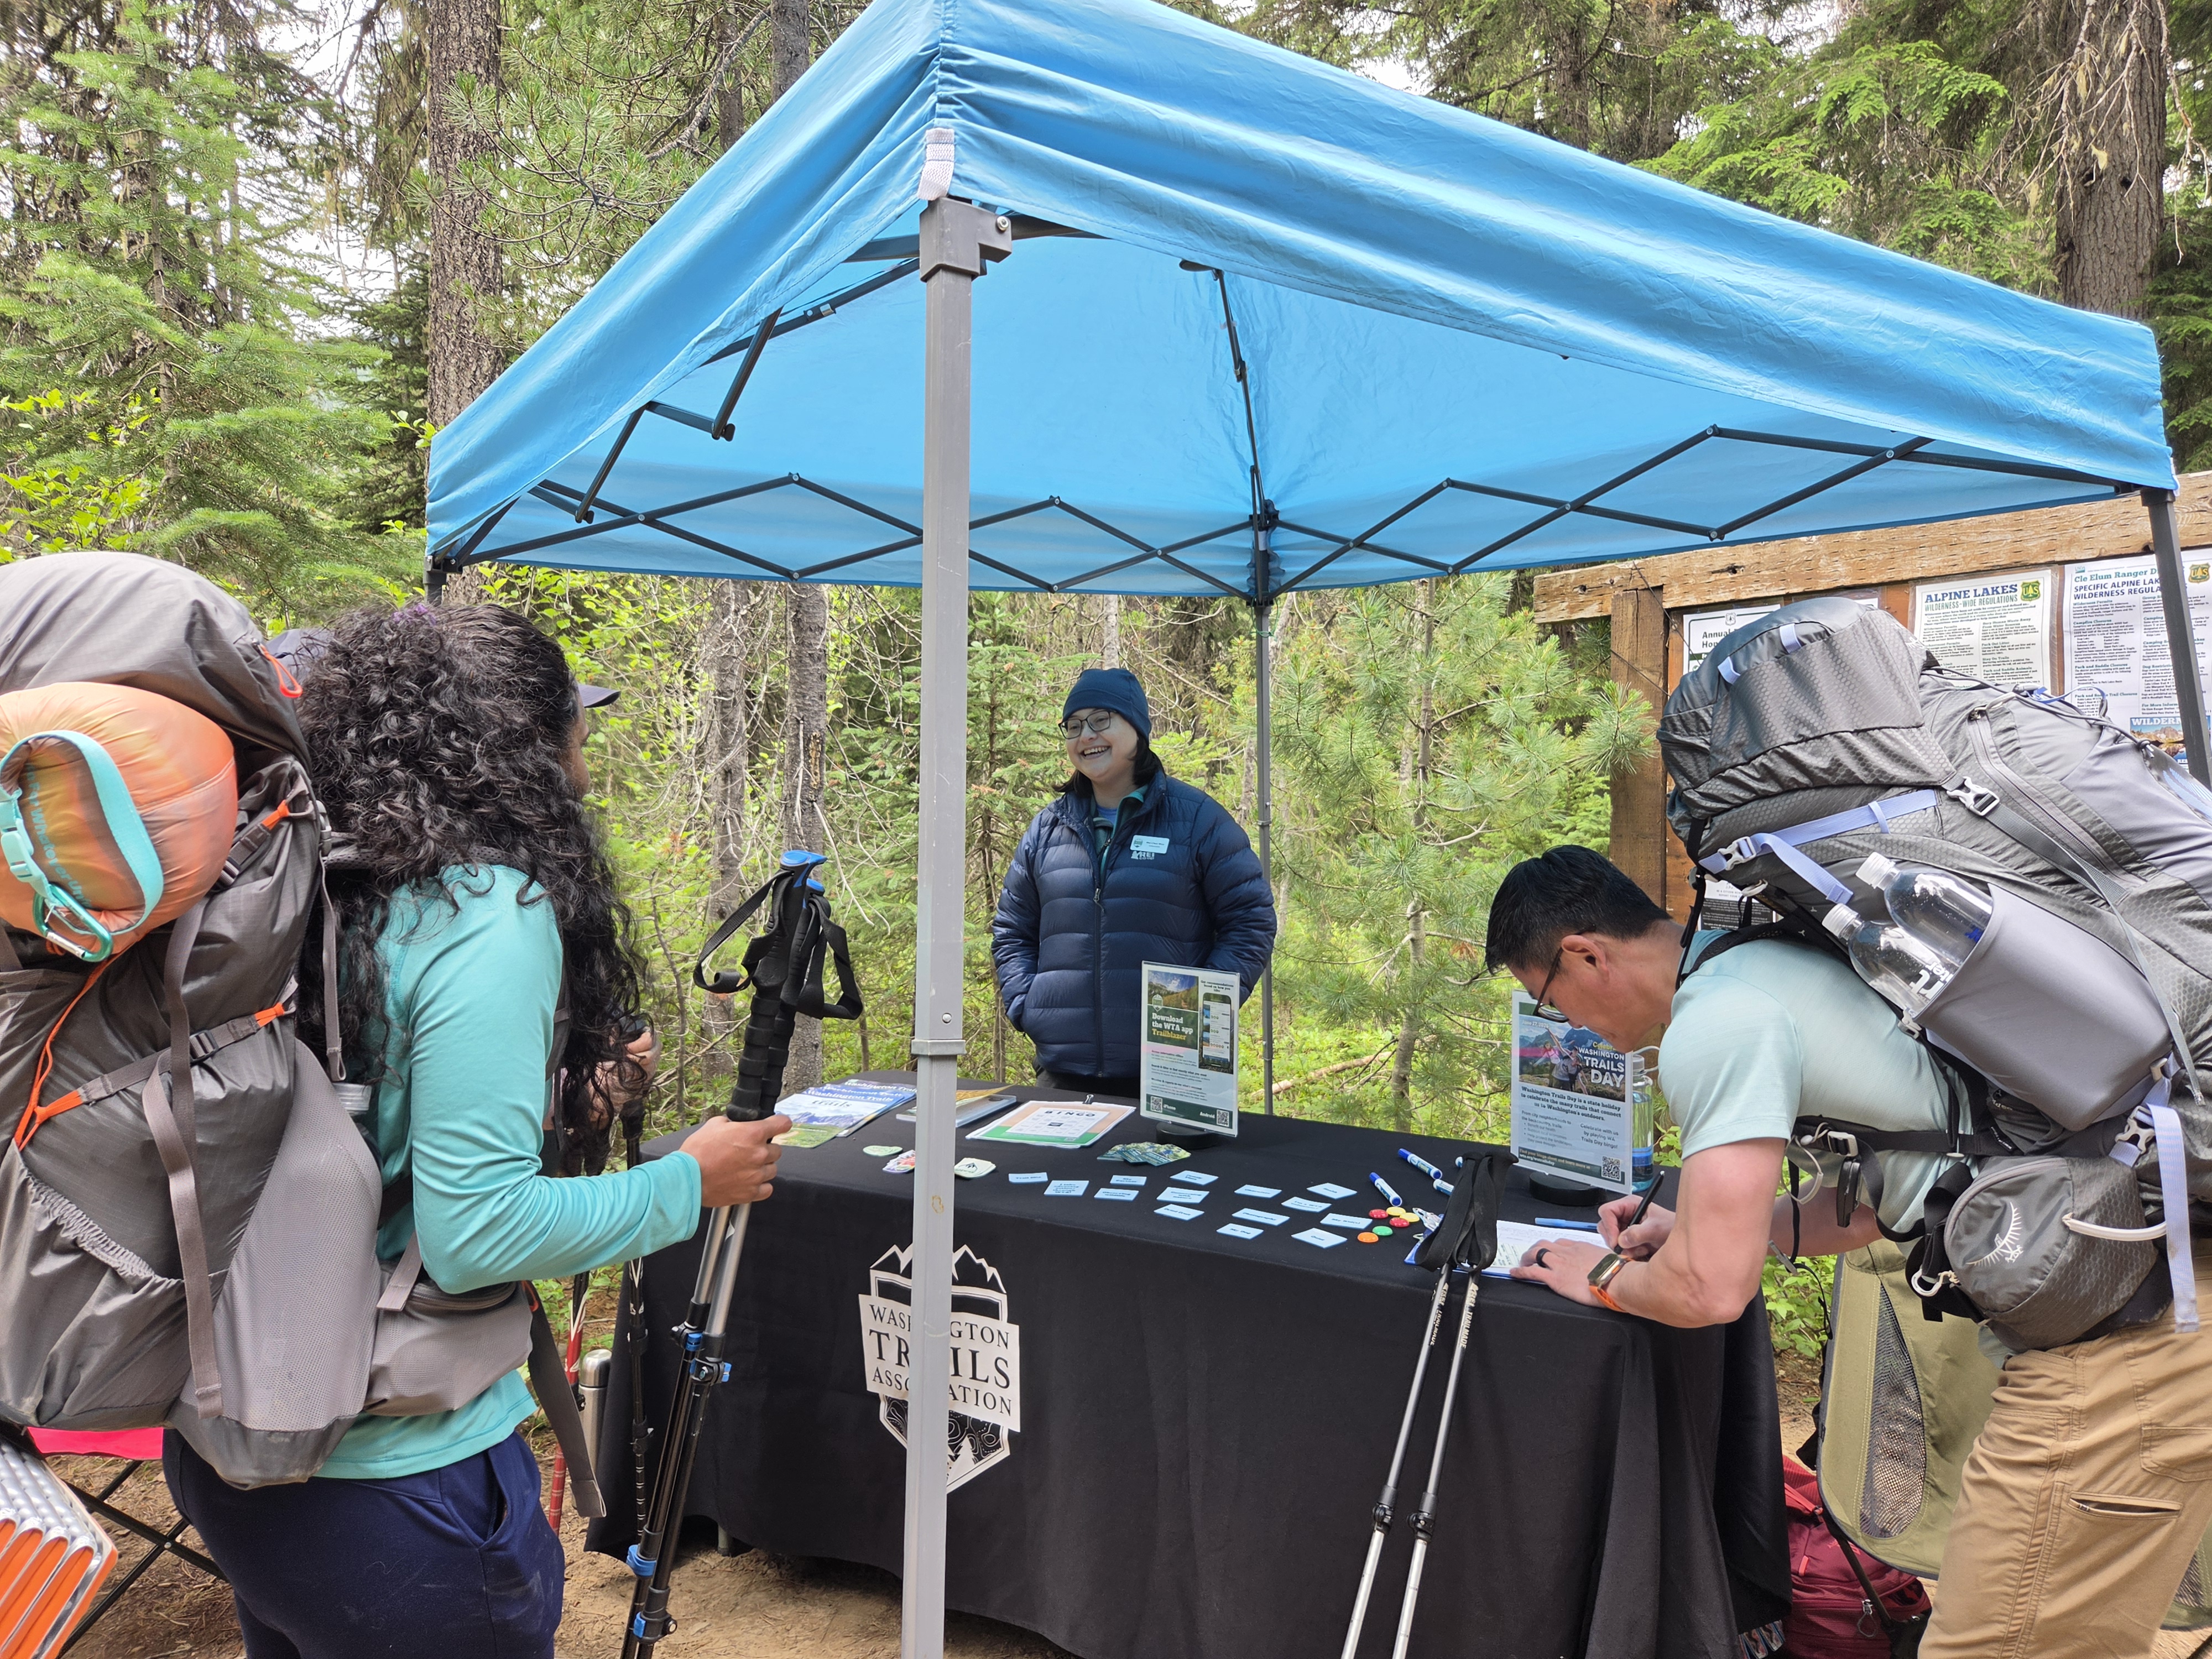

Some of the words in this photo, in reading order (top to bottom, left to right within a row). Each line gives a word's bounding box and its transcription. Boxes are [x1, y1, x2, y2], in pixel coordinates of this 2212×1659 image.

[2090, 572, 2111, 581] Elum
[1925, 590, 1970, 603] ALPINE
[1973, 584, 2017, 597] LAKES
[2074, 583, 2108, 592] SPECIFIC
[2111, 580, 2140, 588] ALPINE
[2074, 588, 2125, 599] WILDERNESS
[2128, 586, 2161, 595] REGULA
[1925, 599, 1976, 612] WILDERNESS-WIDE
[1979, 594, 2017, 606] REGULATIONS
[28, 782, 40, 807] For
[30, 807, 72, 881] Whatever
[1152, 1013, 1183, 1024] Download
[1152, 1029, 1187, 1040] Trailblazer
[1164, 1023, 1180, 1031] WTA
[1181, 1026, 1193, 1035] app
[1593, 1041, 1616, 1051] Celebr
[1578, 1047, 1625, 1061] WASHINGTON
[1584, 1056, 1625, 1073] TRAILS
[1591, 1068, 1624, 1088] DAY
[807, 1090, 865, 1099] Washington
[1522, 1086, 1550, 1097] Washington
[1601, 1102, 1621, 1112] holiday
[1527, 1094, 1549, 1102] celebrate
[1601, 1109, 1621, 1118] connect
[1547, 1104, 1580, 1115] Washington's
[1581, 1112, 1605, 1121] outdoors.
[1539, 1114, 1566, 1124] neighborhoods
[1580, 1124, 1601, 1132] Celebrate
[1590, 1131, 1606, 1140] playing
[1604, 1140, 1618, 1149] bingo!
[869, 1304, 1009, 1349] WASGTON
[1460, 1311, 1473, 1349] TRAILMADE
[869, 1328, 1010, 1389] TRILS
[872, 1366, 1011, 1416] ASSATION
